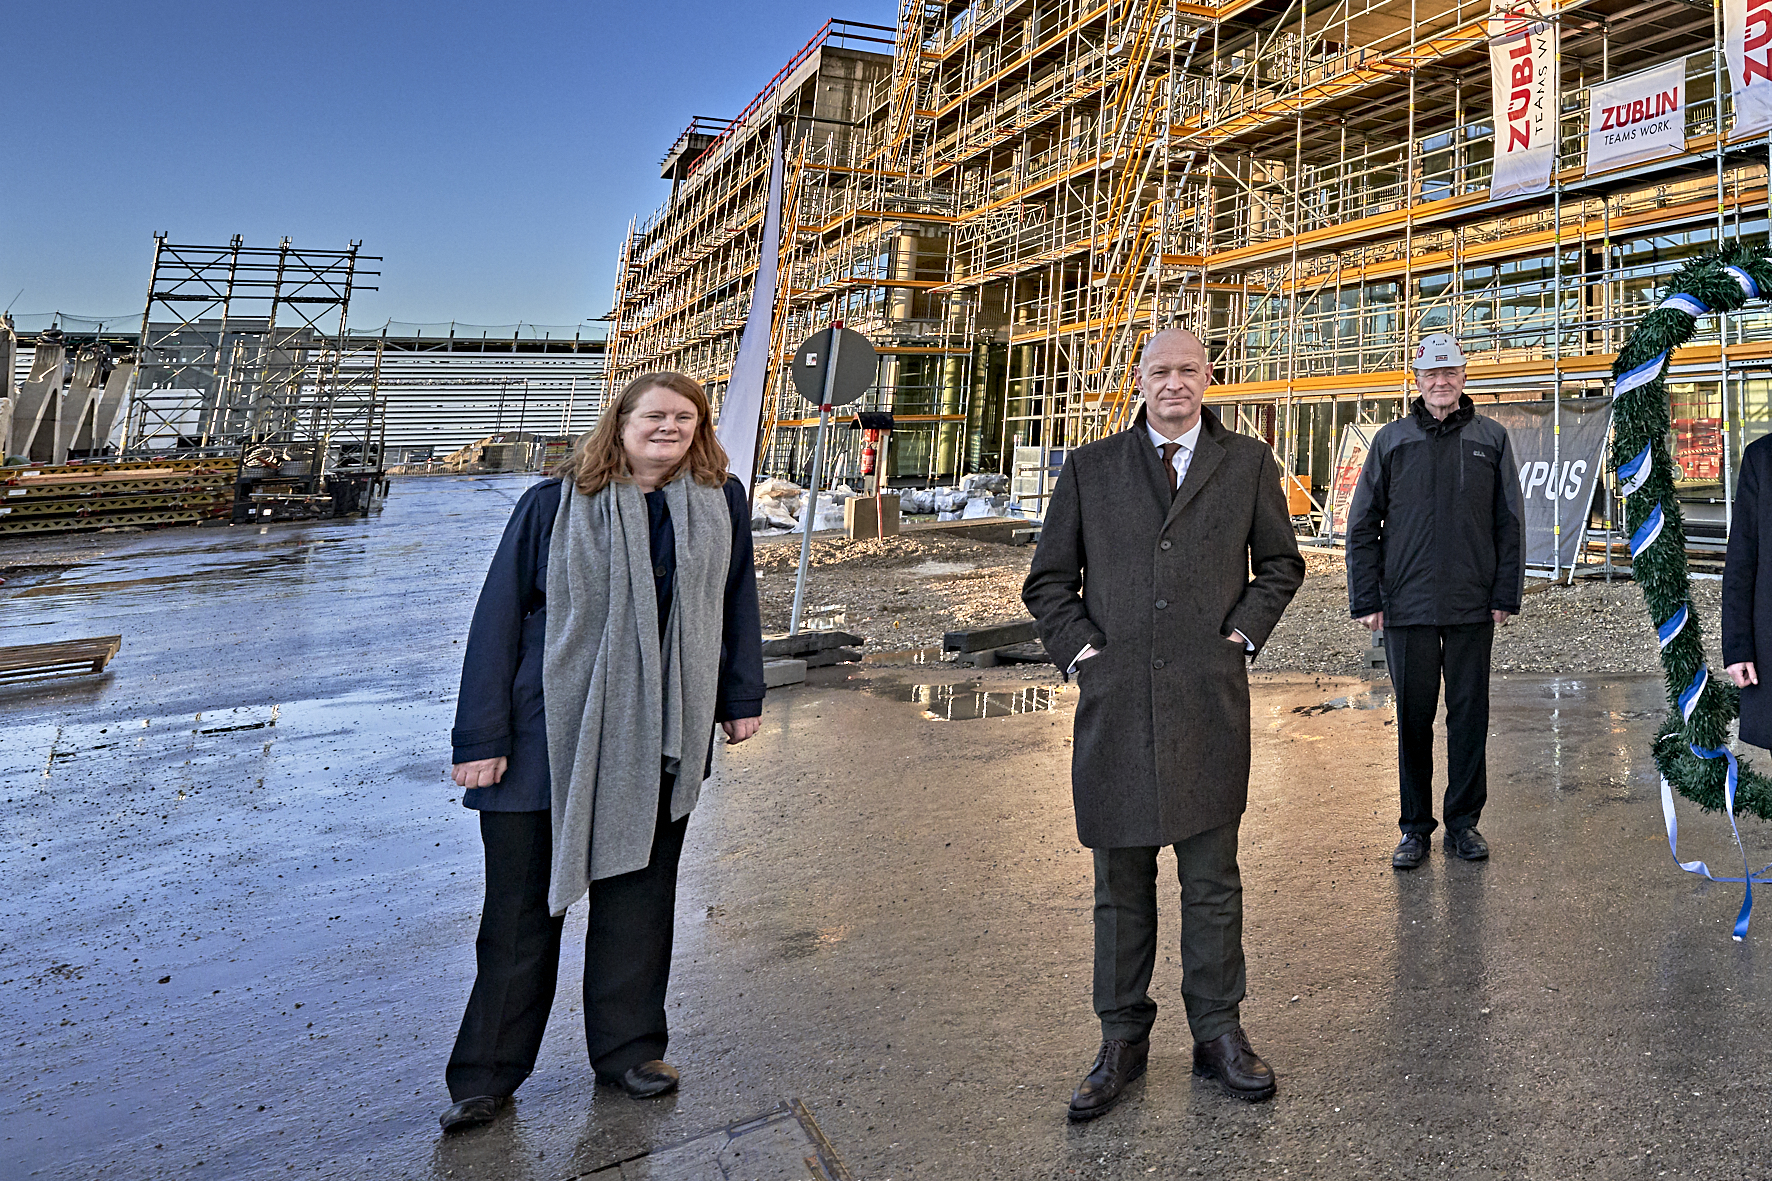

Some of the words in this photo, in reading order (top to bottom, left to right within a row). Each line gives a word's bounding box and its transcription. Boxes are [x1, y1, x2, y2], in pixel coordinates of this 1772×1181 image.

[1534, 66, 1548, 136] TEAMS
[1600, 86, 1678, 132] ZÜBLIN
[1605, 129, 1637, 146] TEAMS
[1640, 119, 1672, 137] WORK.
